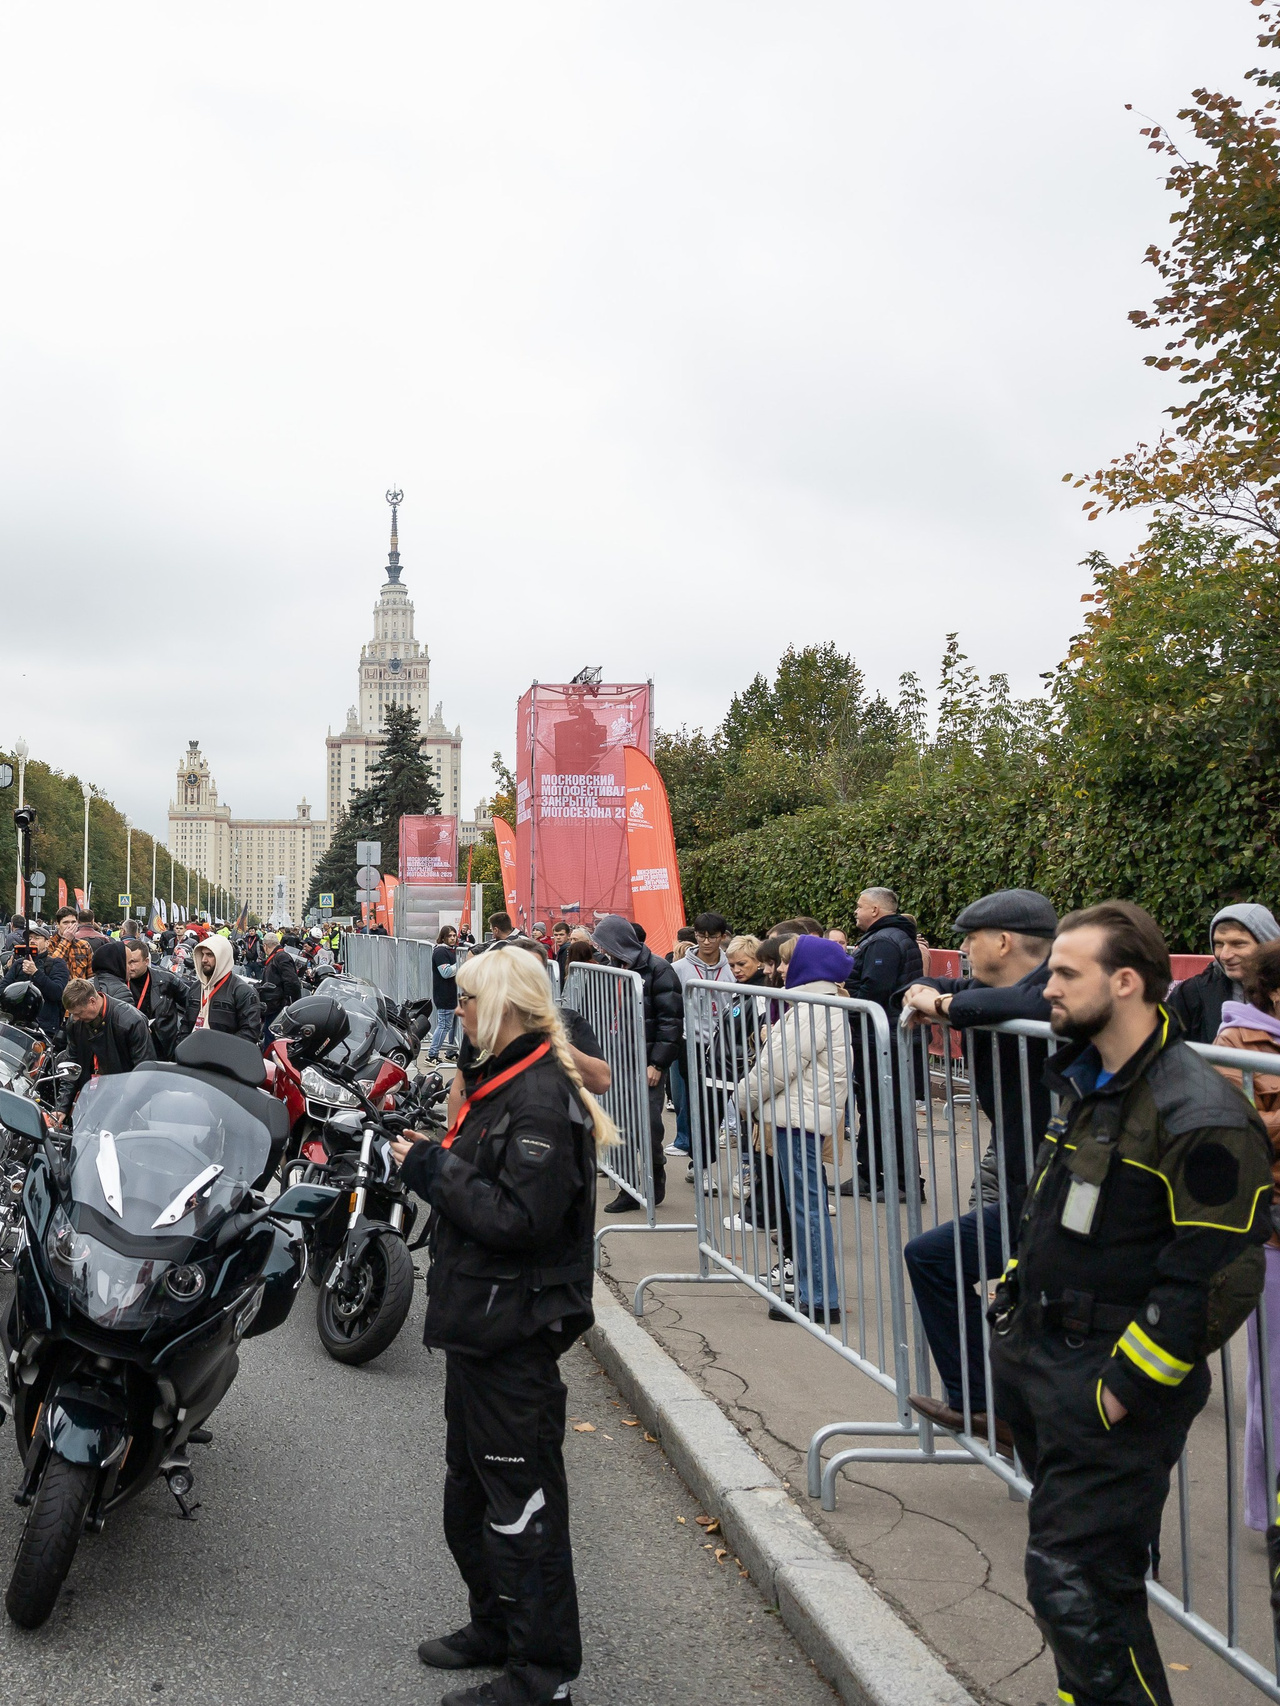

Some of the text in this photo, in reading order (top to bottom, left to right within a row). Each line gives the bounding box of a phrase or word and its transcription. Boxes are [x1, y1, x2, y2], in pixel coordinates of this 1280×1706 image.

[541, 773, 615, 786] МОСКОВСКИЙ
[541, 785, 626, 797] МОТОФЕСТИВАЛ
[541, 796, 598, 808] ЗАКРЫТИЕ
[541, 807, 612, 819] МОТОСЕЗОНА
[484, 1454, 526, 1463] MACNA
